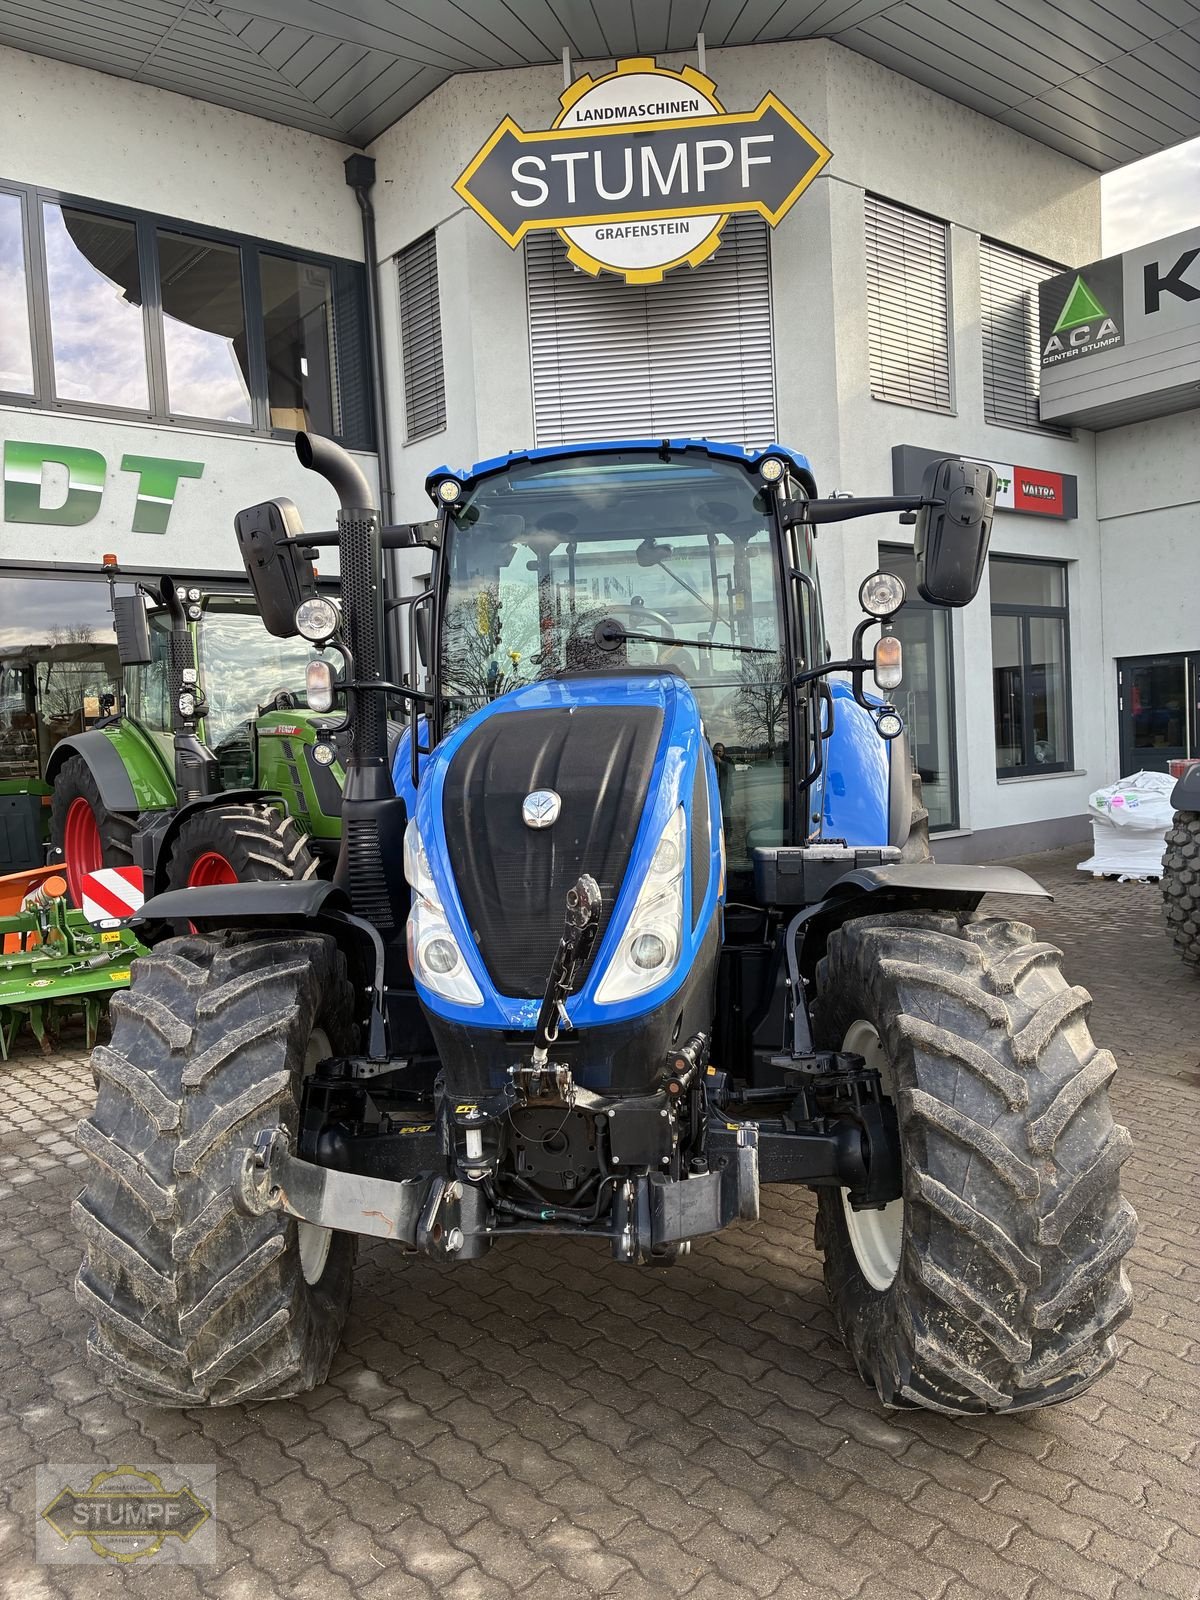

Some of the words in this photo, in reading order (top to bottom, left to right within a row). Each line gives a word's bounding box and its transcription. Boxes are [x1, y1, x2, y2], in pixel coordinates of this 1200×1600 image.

[576, 100, 699, 122] LANDMASCHINEN
[510, 134, 775, 207] STUMPF
[595, 222, 690, 241] GRAFENSTEIN
[1042, 348, 1079, 364] CENTER
[1081, 335, 1121, 353] STUMPF
[1043, 318, 1119, 356] ACA
[4, 439, 205, 535] DT
[1021, 482, 1056, 498] VALTRA
